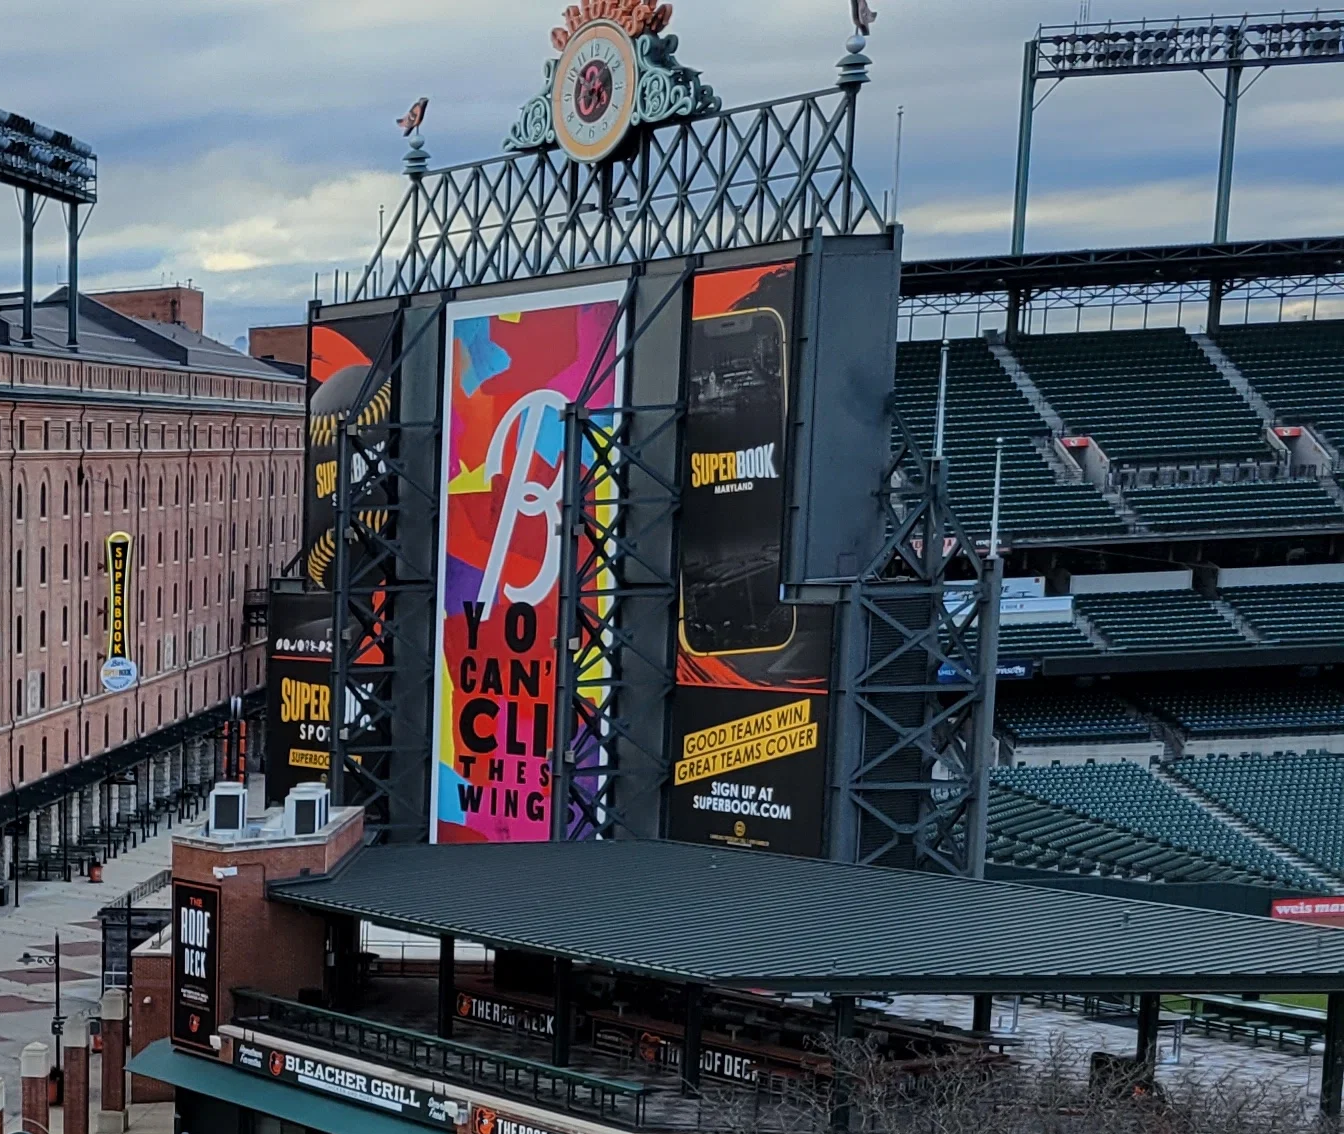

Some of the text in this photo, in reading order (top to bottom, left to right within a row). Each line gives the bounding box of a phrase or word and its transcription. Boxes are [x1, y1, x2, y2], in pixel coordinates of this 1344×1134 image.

[691, 442, 776, 488] SUPERBOOK
[714, 481, 753, 495] MARYLAND
[113, 547, 123, 654] SUPERBOOK
[463, 601, 538, 654] YO
[459, 656, 552, 697] CAN'
[459, 697, 549, 758] CLI
[685, 704, 807, 755] GOOD TEAMS WIN,
[459, 755, 549, 787] THES
[677, 728, 814, 781] GREAT TEAMS COVER
[457, 784, 545, 821] WING
[693, 795, 792, 820] SUPERBOOK.COM
[711, 781, 774, 801] SIGN UP AT
[180, 906, 211, 949] ROOF
[1275, 902, 1313, 915] weis
[184, 948, 207, 979] DECK
[472, 998, 491, 1021] THE
[285, 1054, 368, 1093] BLEACHER
[370, 1079, 421, 1108] GRILL
